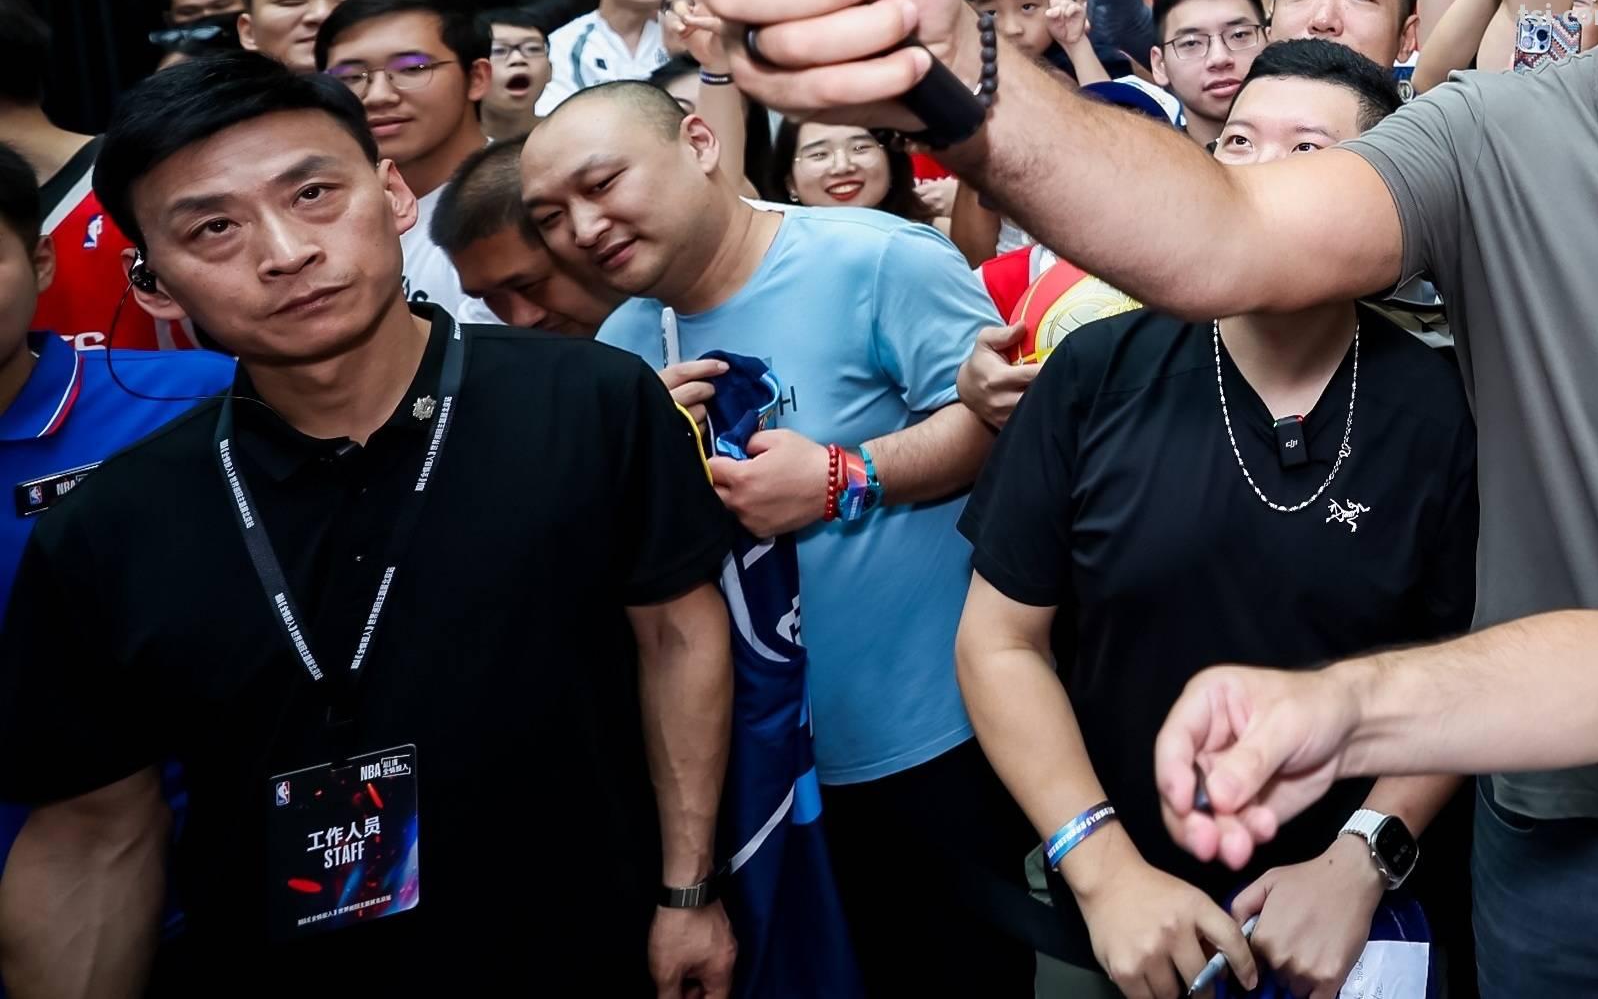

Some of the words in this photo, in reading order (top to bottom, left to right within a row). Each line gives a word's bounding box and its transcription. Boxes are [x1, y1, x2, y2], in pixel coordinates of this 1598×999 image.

[360, 762, 382, 782] NBA
[306, 815, 382, 852] 工作人员
[324, 840, 366, 869] STAFF
